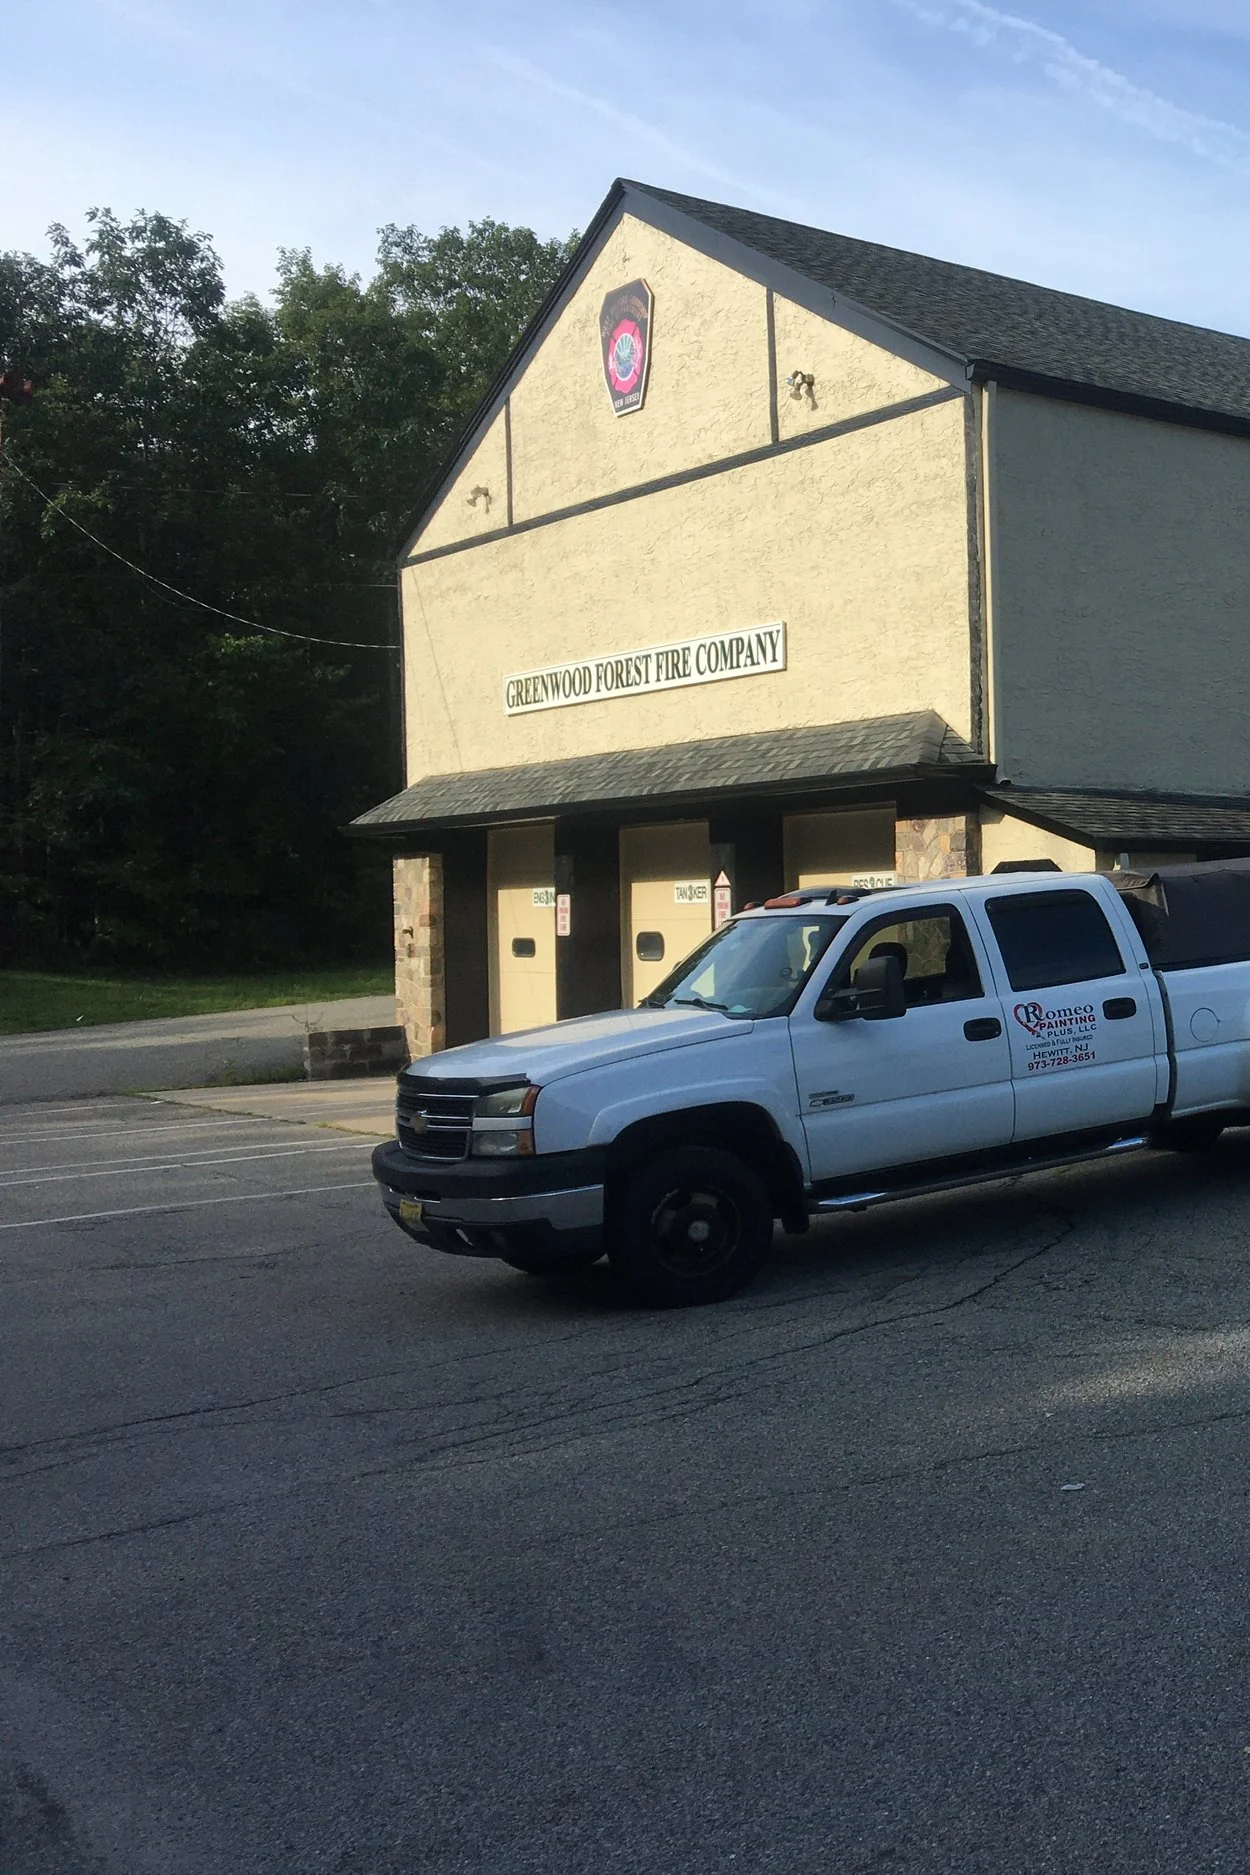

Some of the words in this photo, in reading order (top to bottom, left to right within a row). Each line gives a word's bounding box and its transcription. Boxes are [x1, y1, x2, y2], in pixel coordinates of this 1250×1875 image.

[506, 665, 592, 709] GREENWOOD
[595, 653, 652, 692] FOREST
[655, 645, 692, 683] FIRE
[695, 630, 782, 675] COMPANY
[1039, 1014, 1096, 1031] PAINTING
[1078, 1023, 1097, 1033] LLC
[1075, 1043, 1089, 1053] NJ
[1027, 1051, 1096, 1071] 973-728-3651
